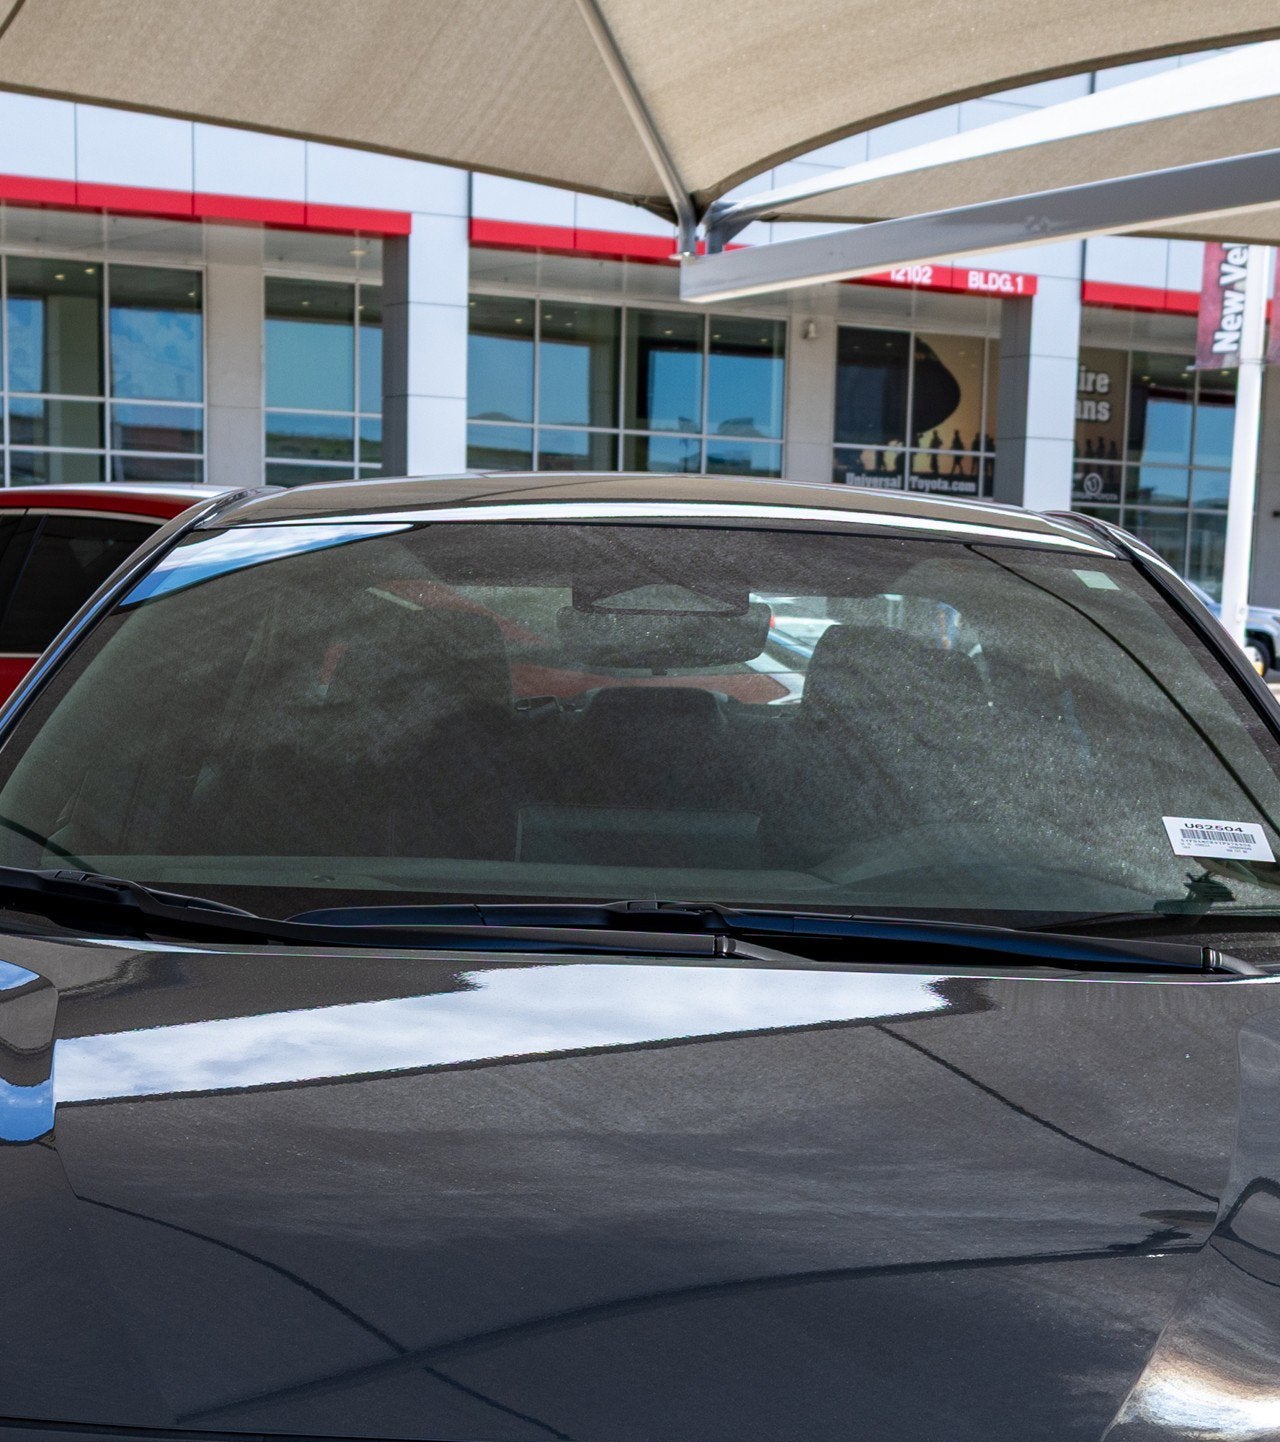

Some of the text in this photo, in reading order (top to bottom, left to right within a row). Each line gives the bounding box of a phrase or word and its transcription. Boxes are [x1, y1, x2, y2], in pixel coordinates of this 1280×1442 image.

[890, 265, 1024, 293] 12102 BLDG. 1
[1212, 290, 1245, 353] New
[846, 473, 976, 492] Universal Toyota.com
[1184, 823, 1243, 833] U62504
